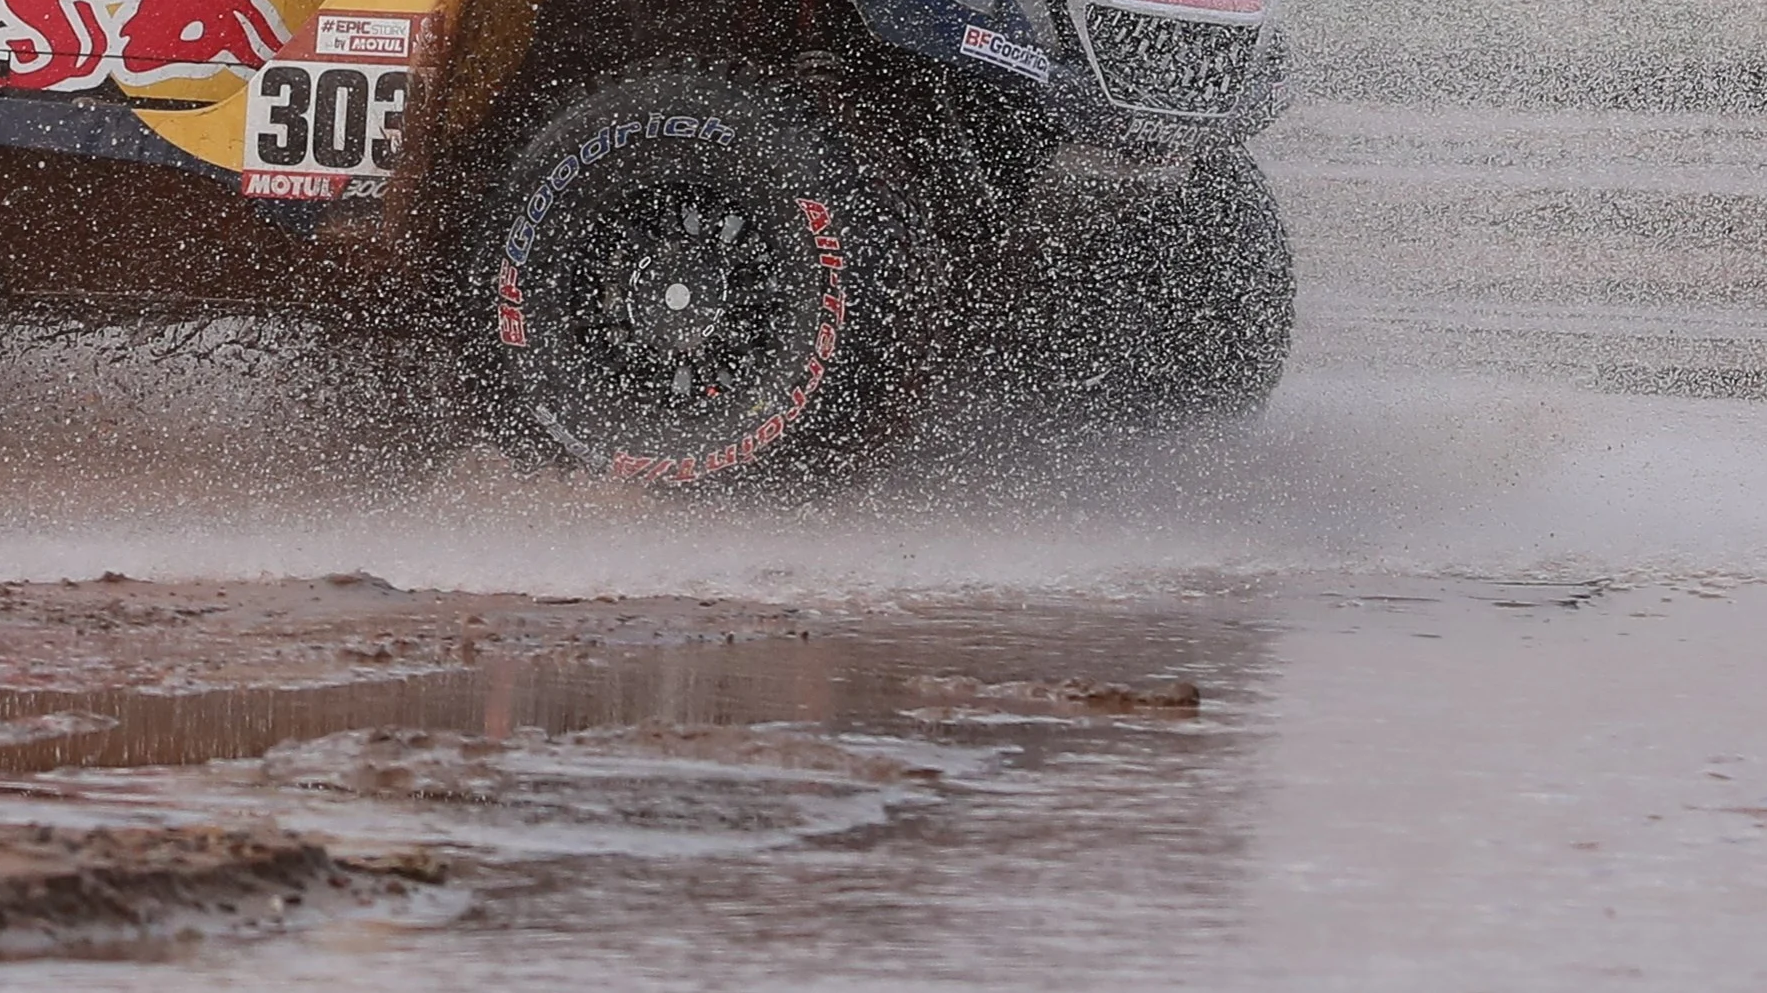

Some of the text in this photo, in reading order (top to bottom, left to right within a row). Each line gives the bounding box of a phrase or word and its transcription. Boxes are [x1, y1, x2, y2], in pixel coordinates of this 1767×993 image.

[335, 37, 402, 52] by MOTUL
[257, 66, 407, 171] 303
[247, 174, 332, 197] MOTUL
[497, 112, 735, 347] BFGoodrich
